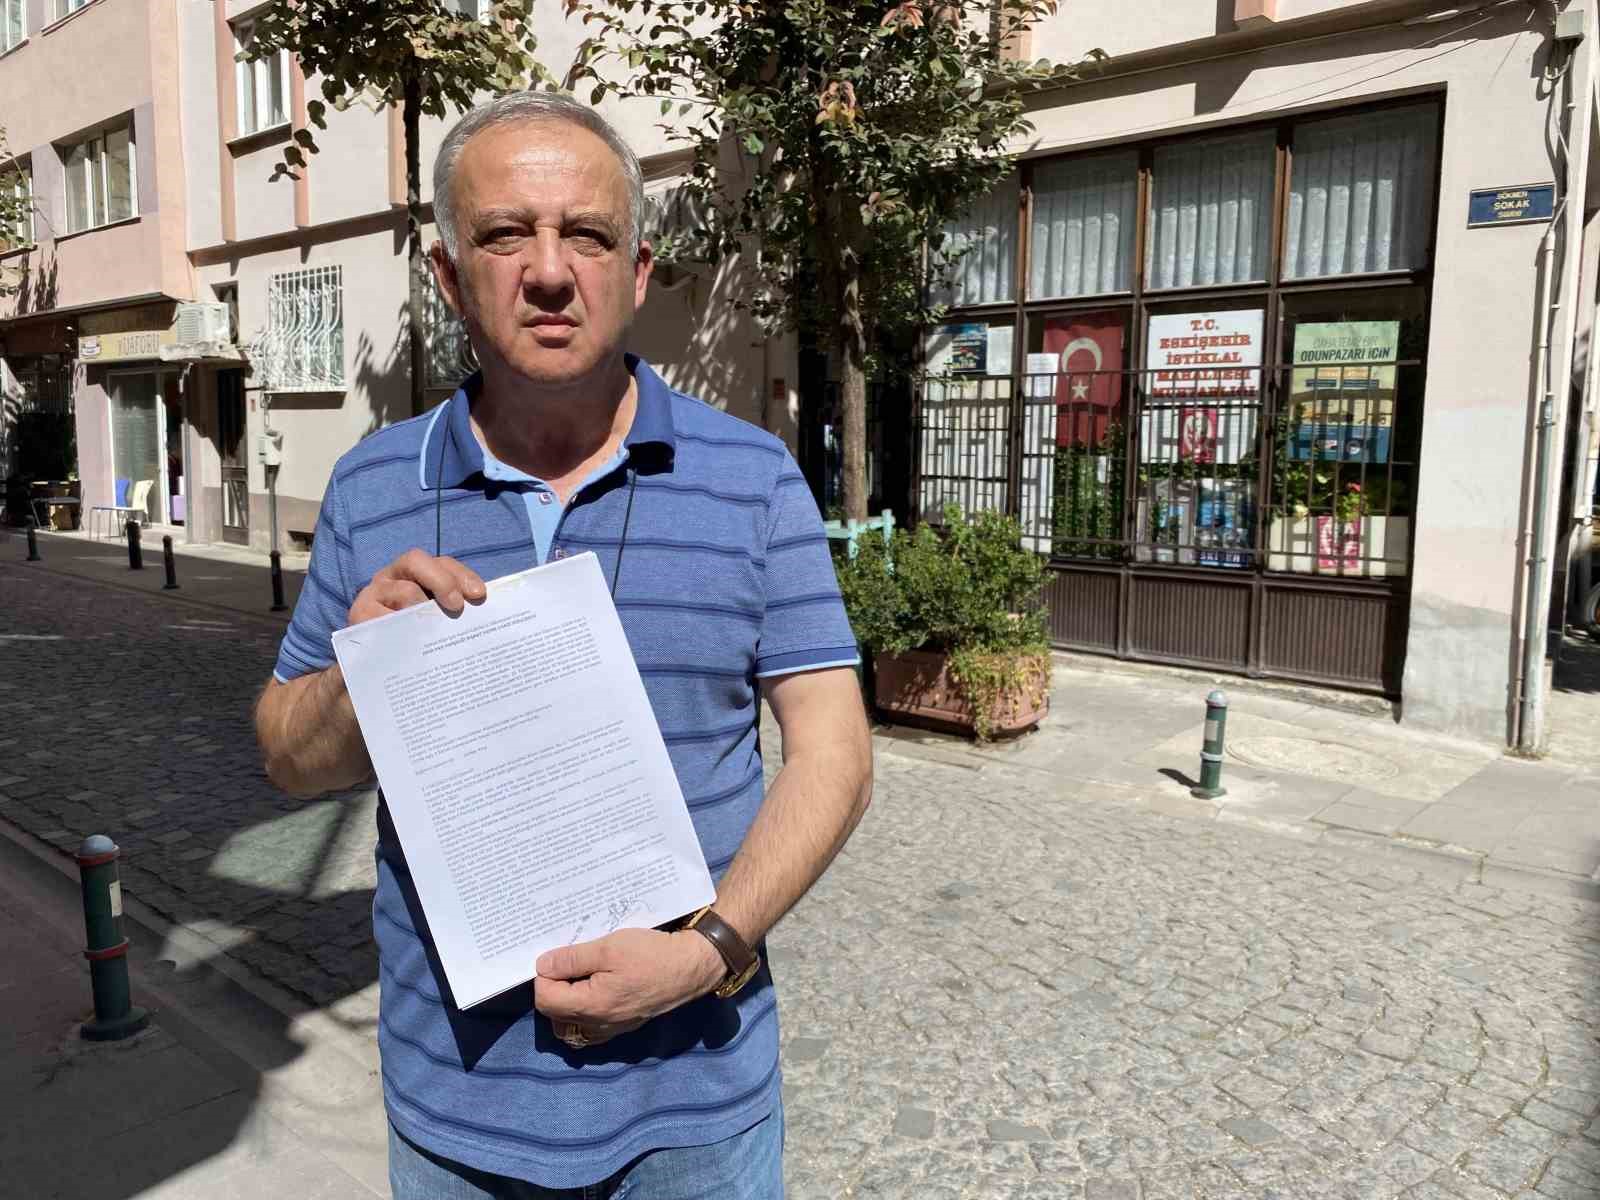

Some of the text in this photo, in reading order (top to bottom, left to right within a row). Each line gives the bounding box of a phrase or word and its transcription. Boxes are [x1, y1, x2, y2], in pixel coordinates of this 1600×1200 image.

[1494, 199, 1531, 210] SOKAK
[1190, 319, 1219, 331] T.C.
[1160, 331, 1252, 350] ESKİŞEHİR
[1166, 350, 1243, 366] İSTİKLAL
[1300, 348, 1365, 362] ODUNPAZARI
